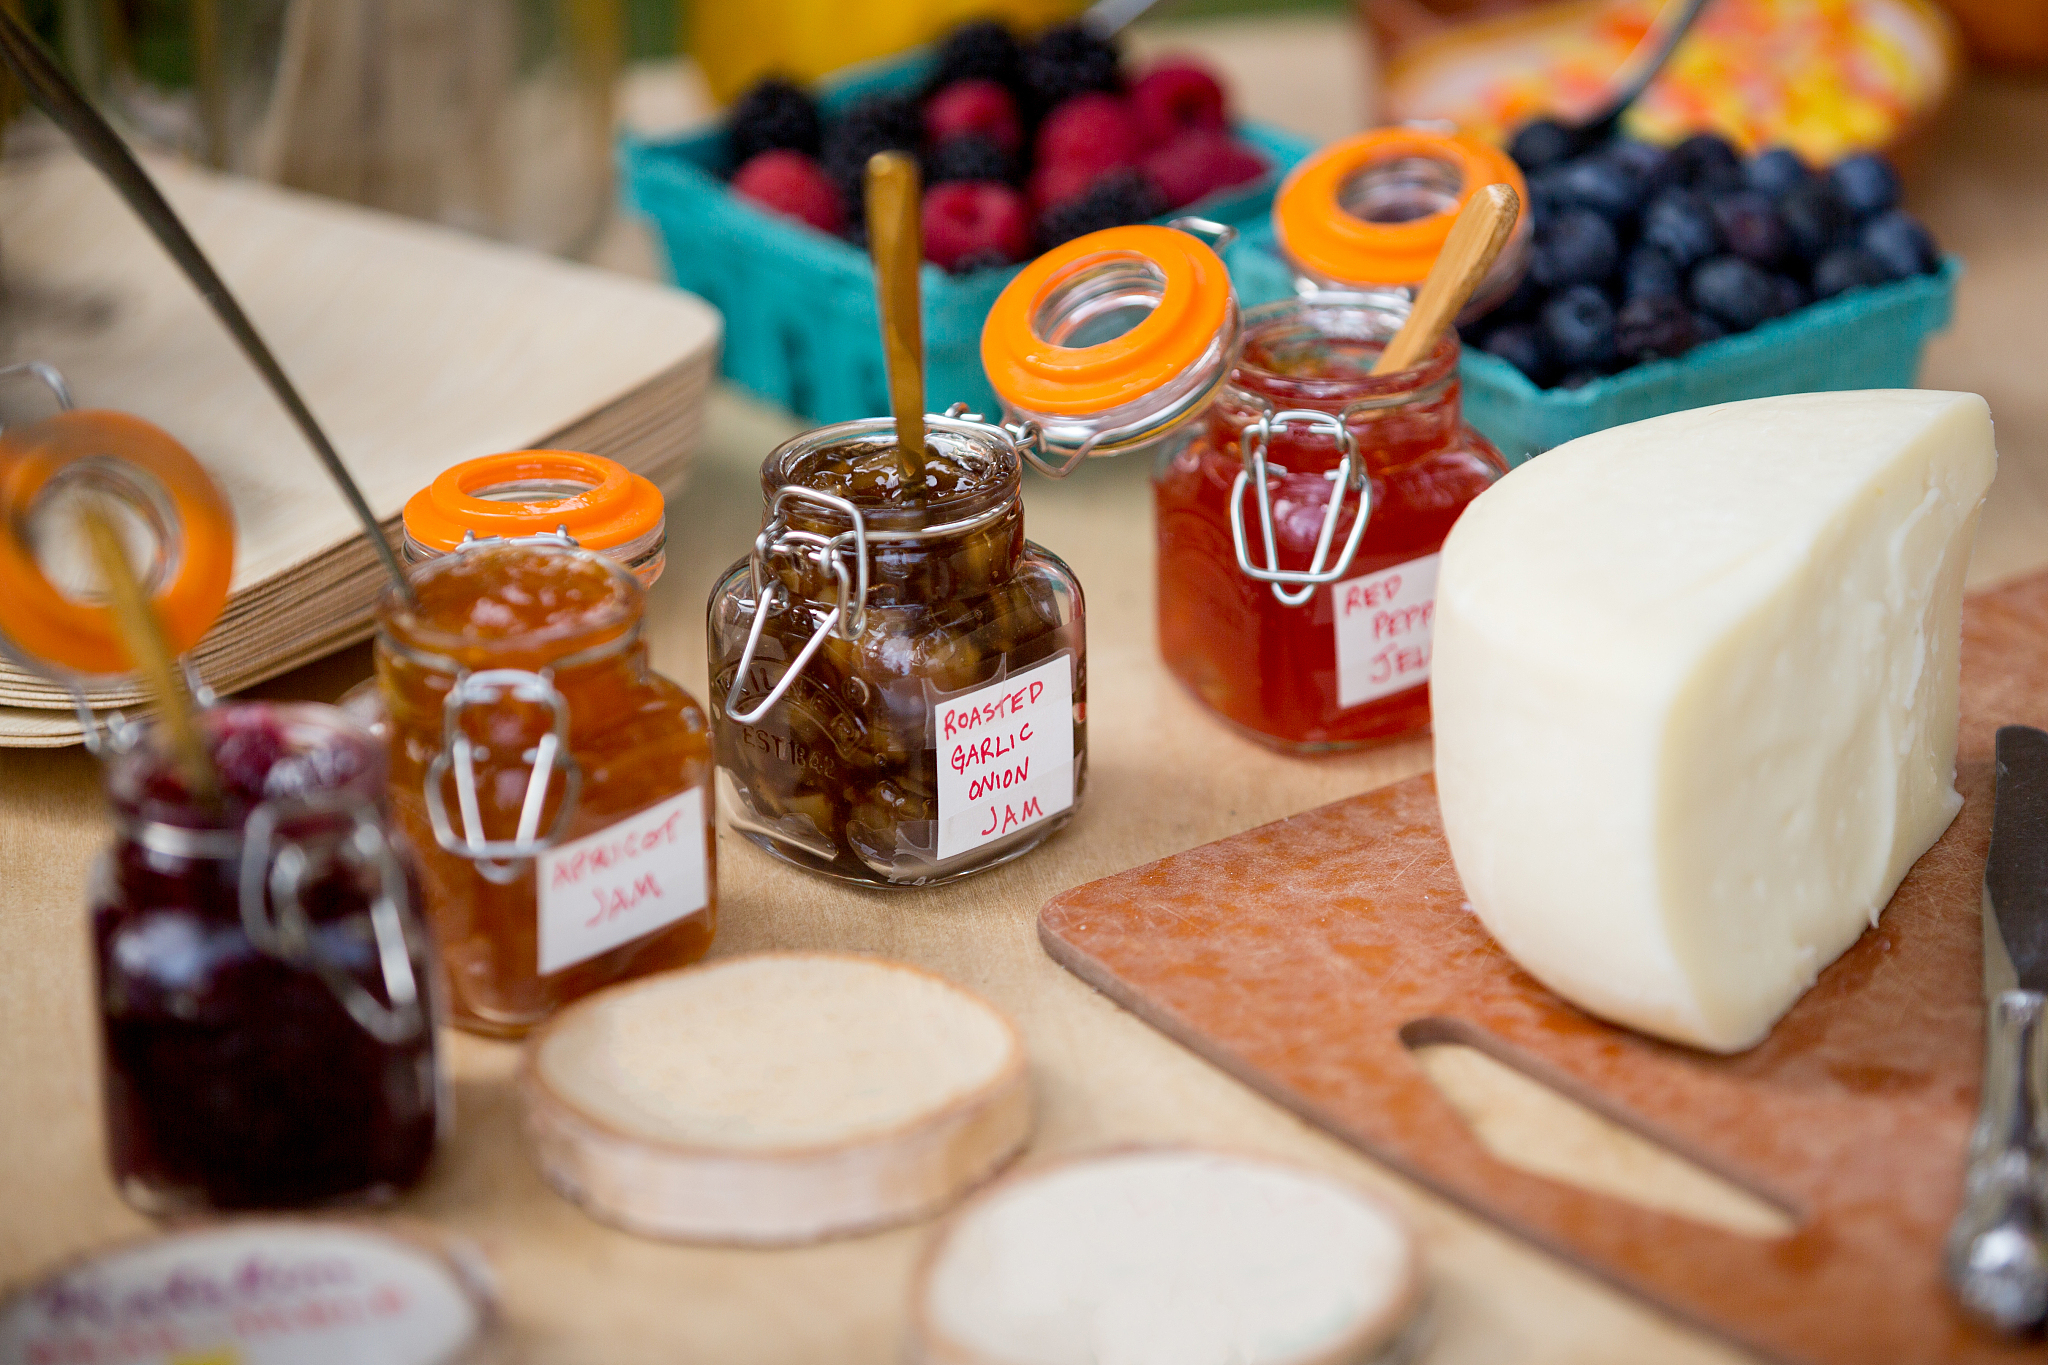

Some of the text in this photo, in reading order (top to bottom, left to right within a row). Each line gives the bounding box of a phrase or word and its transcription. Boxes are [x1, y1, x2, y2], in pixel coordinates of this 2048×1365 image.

[1344, 574, 1402, 617] RED
[1370, 643, 1432, 684] JEL
[943, 681, 1044, 740] ROASTED
[951, 723, 1034, 775] GARLIC
[968, 756, 1029, 801] ONION
[981, 796, 1044, 836] JAM
[552, 809, 682, 890] APRICOT
[585, 871, 664, 928] JAM
